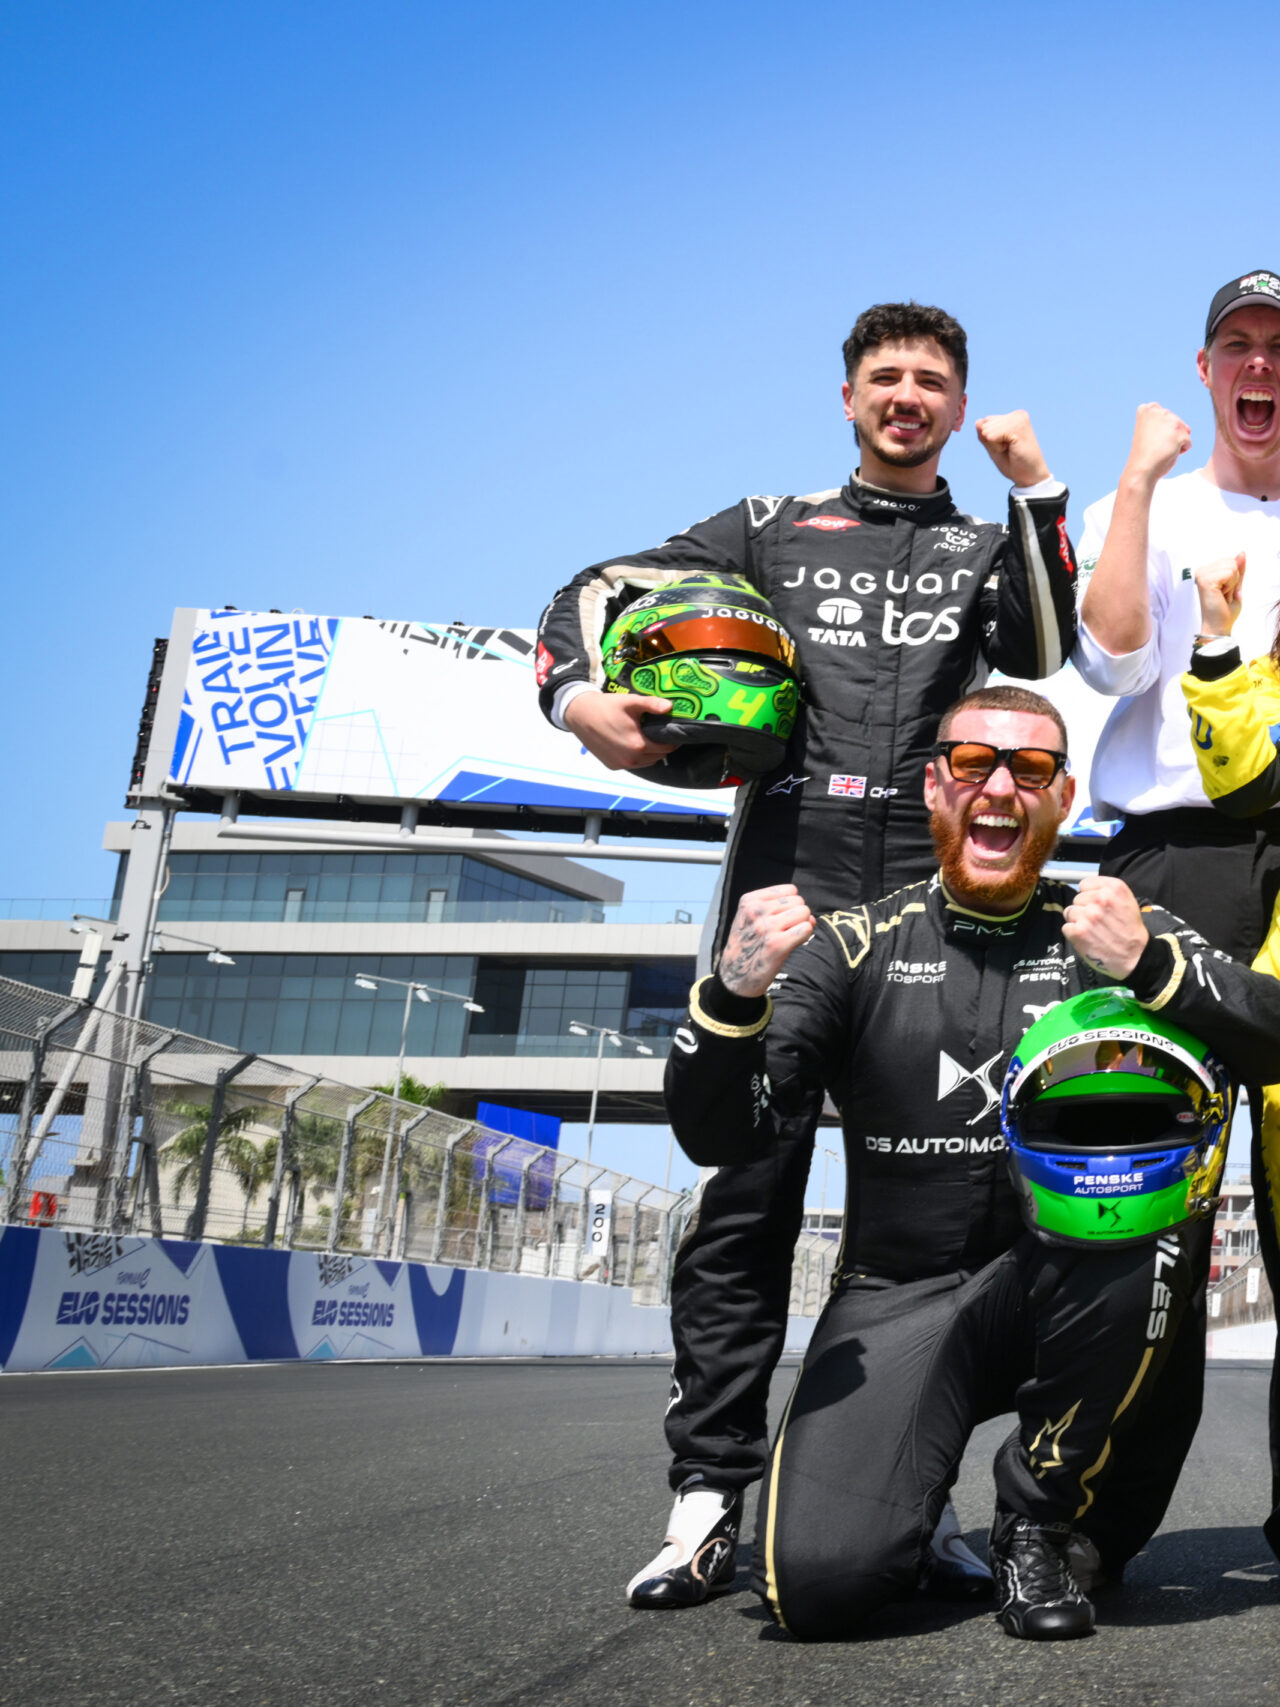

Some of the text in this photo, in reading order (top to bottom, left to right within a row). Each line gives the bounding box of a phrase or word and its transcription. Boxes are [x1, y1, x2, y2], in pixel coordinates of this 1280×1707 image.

[807, 599, 962, 647] TATA tcs
[727, 689, 767, 726] 4
[1047, 1030, 1175, 1056] EVO SESSIONS
[865, 1136, 893, 1153] DS
[1073, 1173, 1144, 1186] PENSKE
[1074, 1184, 1144, 1194] AUTOSPORT
[591, 1203, 606, 1242] 200
[56, 1291, 191, 1326] EVO SESSIONS
[338, 1301, 394, 1328] SESSIONS
